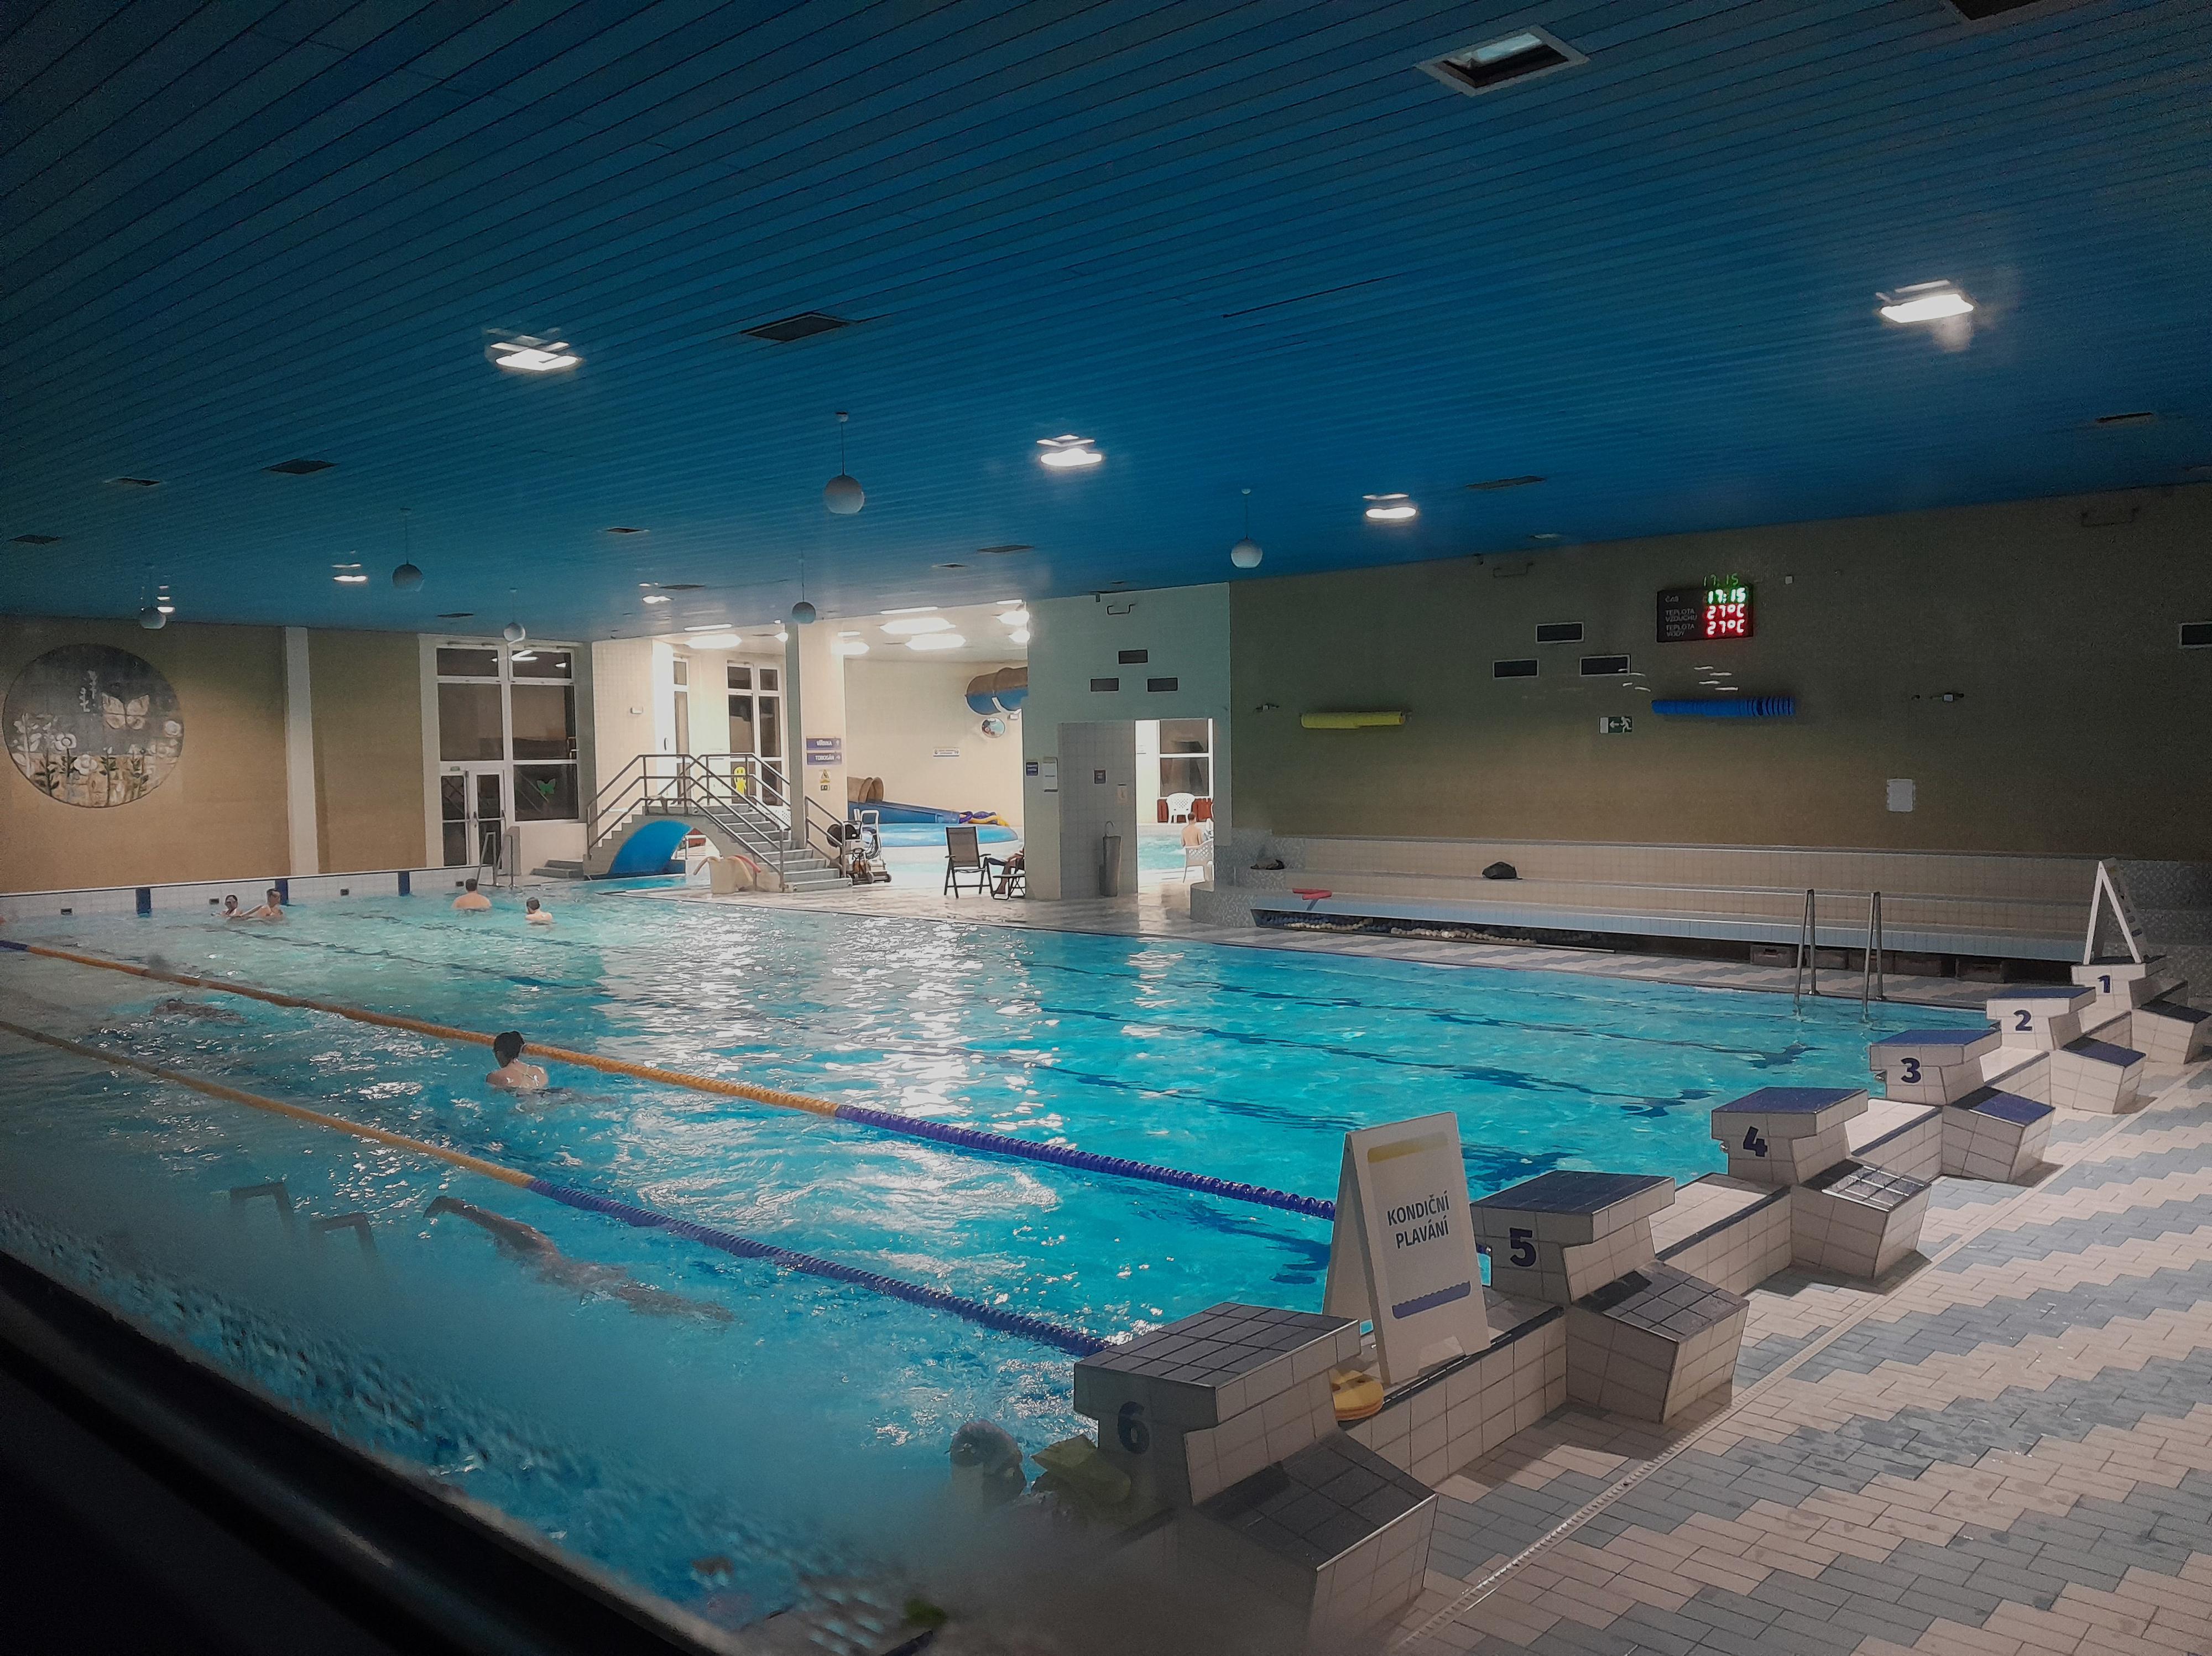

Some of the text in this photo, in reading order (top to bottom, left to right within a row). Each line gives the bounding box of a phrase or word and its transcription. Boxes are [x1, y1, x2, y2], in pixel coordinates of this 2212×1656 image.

[1708, 587, 1746, 603] 17:15
[2097, 975, 2110, 993] 1
[2013, 1009, 2033, 1032] 2
[1901, 1058, 1921, 1084] 3
[1743, 1126, 1768, 1157] 4
[1387, 1190, 1450, 1226] KONDIČNÍ
[1396, 1215, 1449, 1249] PLAVÁNÍ
[1510, 1227, 1537, 1267] 5
[1118, 1401, 1150, 1455] 6
